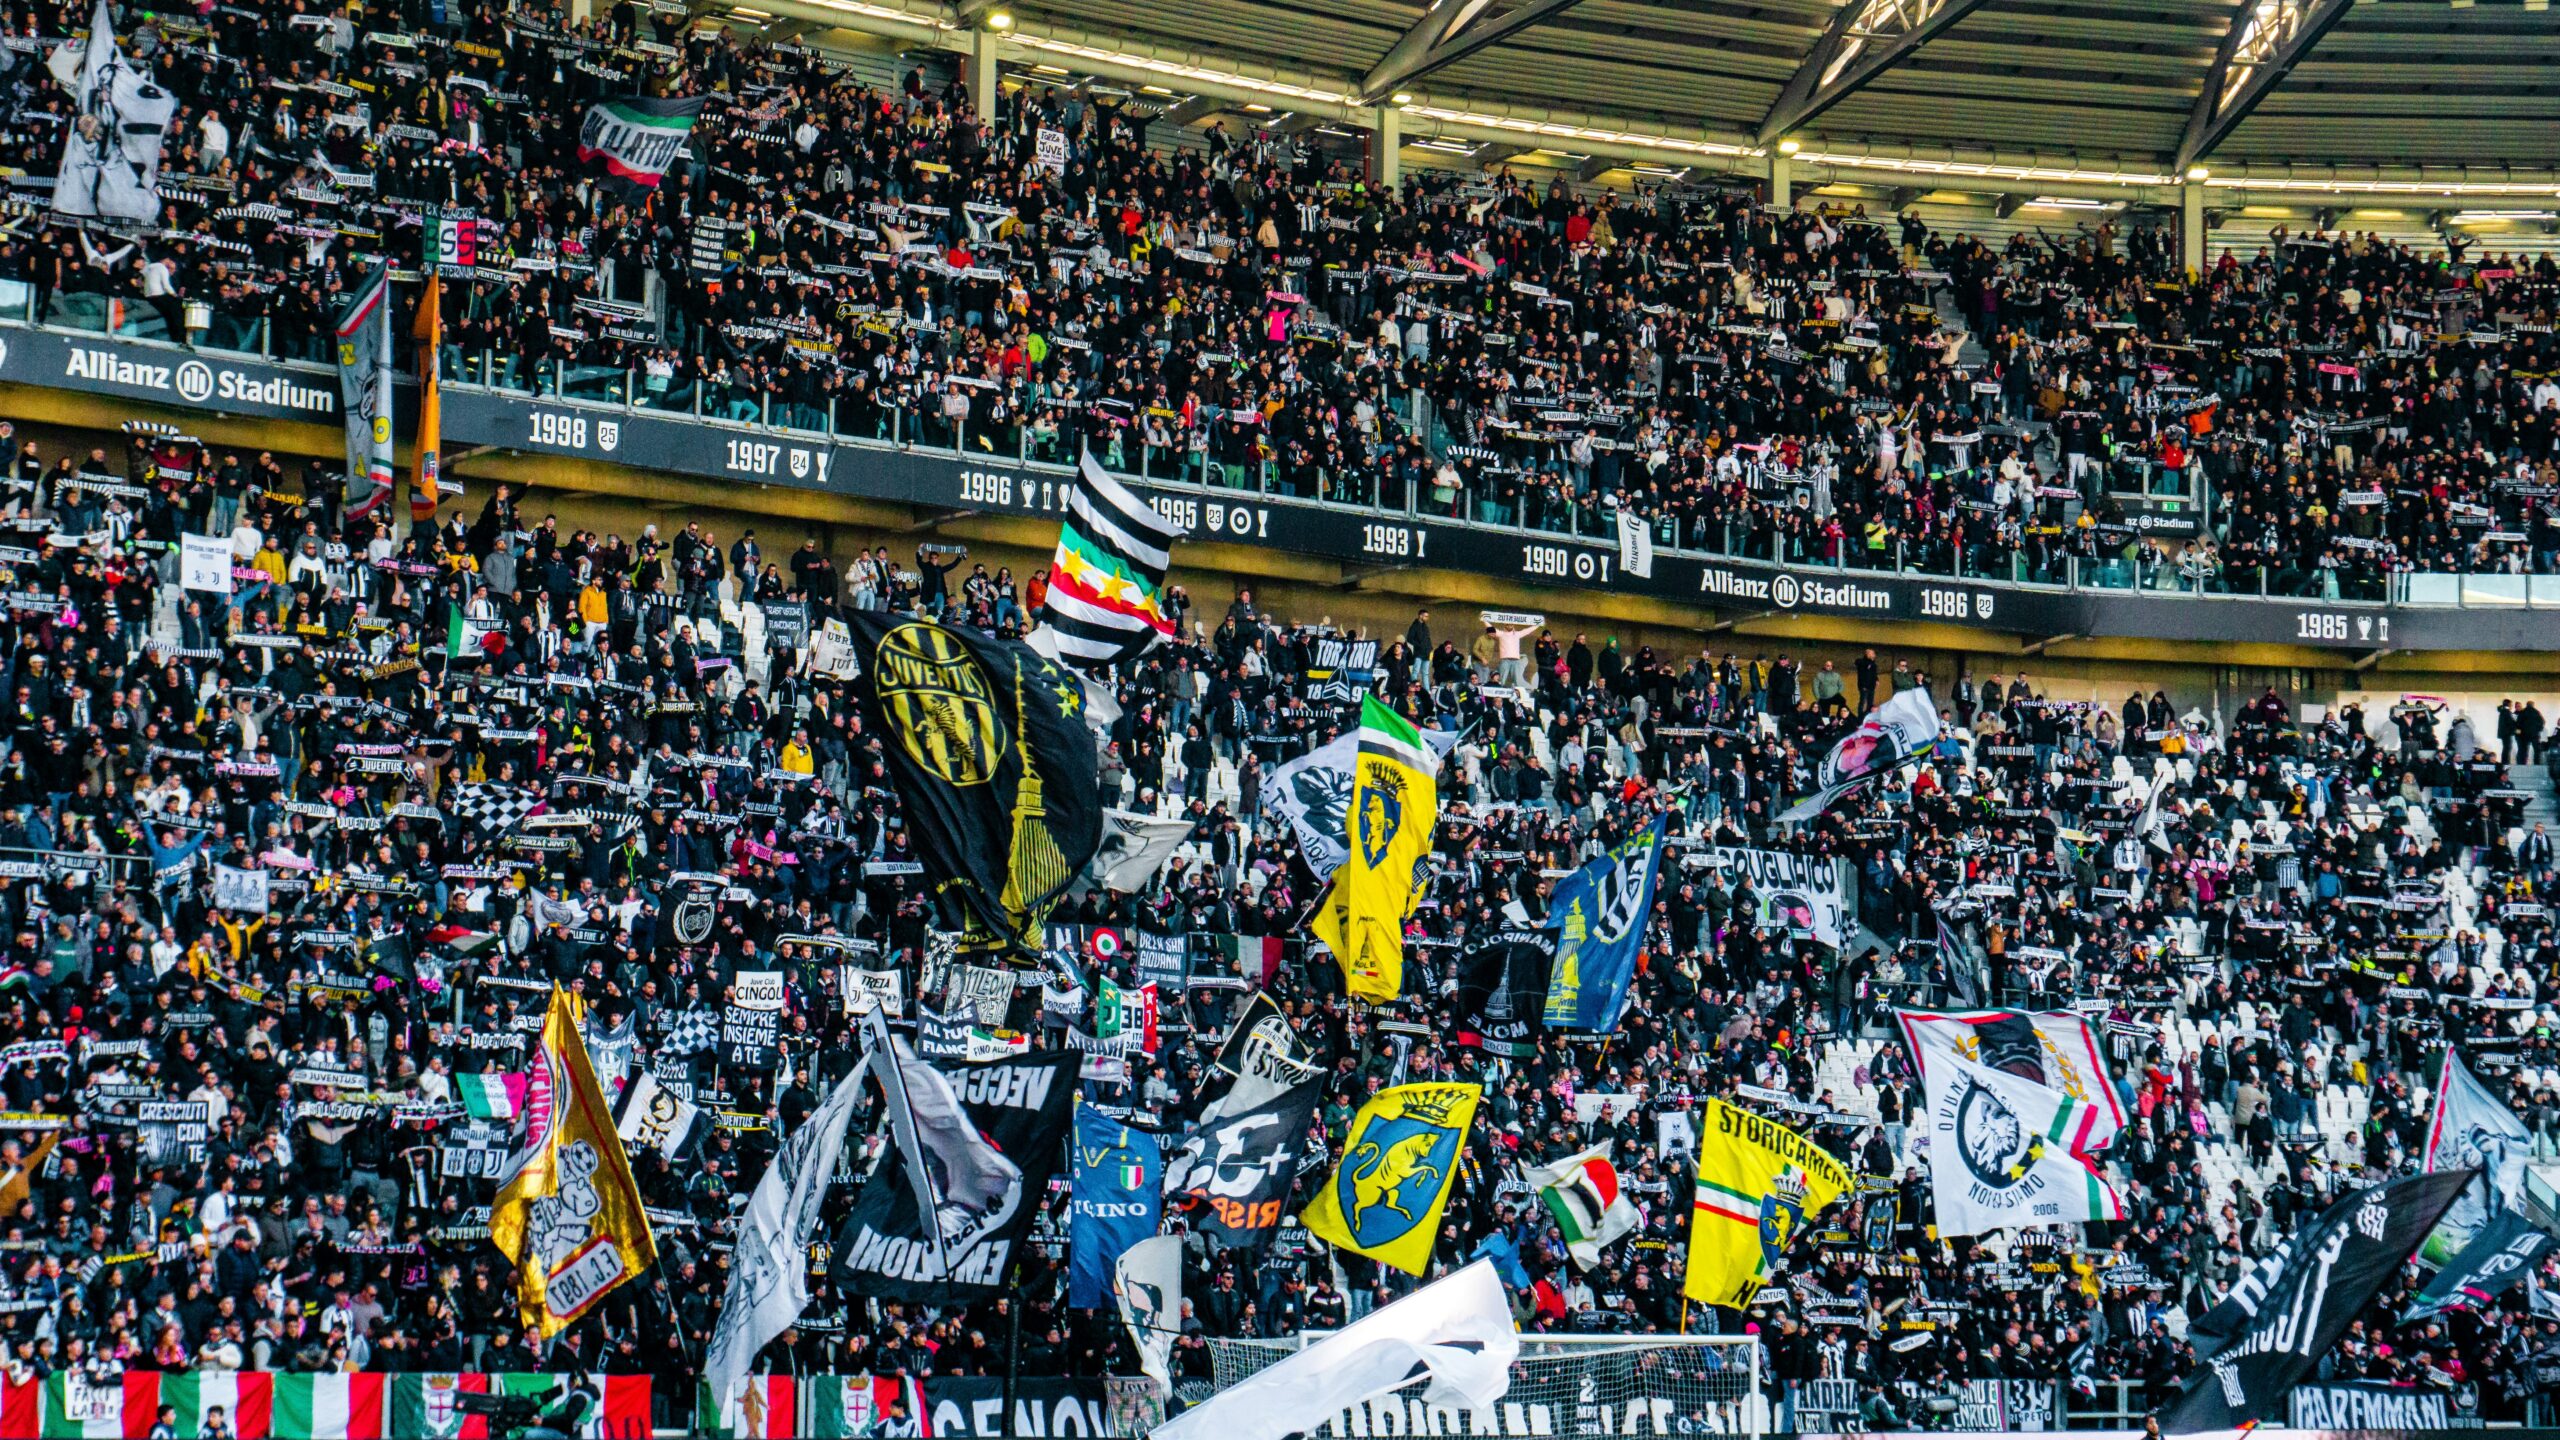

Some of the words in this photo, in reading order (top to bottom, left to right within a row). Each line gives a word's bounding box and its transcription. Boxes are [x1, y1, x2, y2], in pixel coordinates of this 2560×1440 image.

[655, 2, 686, 13] JUVENTUS
[320, 82, 353, 96] JUVENTUS
[348, 79, 374, 92] JUVENTUS
[1039, 142, 1062, 155] JUVE
[338, 175, 371, 186] JUVENTUS
[301, 188, 337, 203] JUVENTUS
[870, 203, 898, 214] JUVENTUS
[1292, 256, 1311, 267] JUVE
[477, 269, 502, 281] VENTUS
[863, 322, 889, 334] JUVENTUS
[911, 318, 937, 330] JUVENTUS
[1308, 322, 1339, 331] JUVENTUS
[608, 326, 618, 336] FINO
[621, 328, 632, 338] ALLA
[634, 331, 645, 341] FINE
[790, 340, 803, 351] FINO
[806, 341, 818, 352] ALLA
[822, 342, 834, 353] FINE
[1058, 338, 1087, 349] JUVENTUS
[1205, 353, 1231, 362] JUVENTUS
[66, 347, 170, 390] Allianz
[217, 371, 333, 413] Stadium
[1149, 408, 1174, 417] JUVENTUS
[1547, 411, 1579, 420] JUVENTUS
[529, 411, 586, 449] 1998
[601, 428, 614, 444] 25
[727, 440, 781, 475] 1997
[792, 455, 804, 471] 24
[160, 468, 190, 481] JUVENTUS
[959, 472, 1011, 505] 1996
[1150, 496, 1196, 529] 1995
[1208, 510, 1221, 525] 23
[2153, 518, 2194, 529] Stadium
[1363, 525, 1408, 556] 1993
[2341, 538, 2374, 548] JUVENTUS
[1626, 535, 1640, 572] JUVENTUS
[1523, 546, 1567, 576] 1990
[1700, 567, 1769, 599] Allianz
[1802, 580, 1890, 609] Stadium
[1921, 589, 1968, 617] 1986
[1978, 599, 1991, 613] 22
[358, 617, 388, 629] JUVENTUS
[2298, 614, 2348, 639] 1985
[827, 633, 850, 644] UBR
[1312, 641, 1375, 670] TORINO
[374, 657, 416, 677] JUVENTUS
[553, 674, 584, 686] JUVENTUS
[879, 655, 982, 697] JUVENTUS
[1307, 686, 1321, 699] 18
[1351, 686, 1368, 702] 97
[662, 702, 695, 713] JUVENTUS
[452, 714, 478, 725] JUVENTUS
[363, 761, 401, 772] JUVENTUS
[704, 755, 739, 765] JUVENTUS
[338, 818, 380, 829] JUVENTUS
[517, 838, 538, 848] FORZA
[547, 839, 567, 849] JUVE
[732, 889, 744, 899] FINE
[303, 932, 315, 941] FINO
[318, 933, 332, 942] ALLA
[334, 934, 347, 943] FINE
[963, 931, 995, 943] MOLE
[1140, 951, 1182, 970] GIOVANNI
[2364, 969, 2393, 980] JUVENTUS
[725, 1006, 776, 1028] SEMPRE
[1121, 1005, 1142, 1027] 38
[724, 1025, 776, 1047] INSIEME
[924, 1022, 940, 1037] AL
[942, 1026, 971, 1040] TUO
[924, 1040, 967, 1055] FIANC
[972, 1043, 989, 1056] FINO
[991, 1043, 1008, 1053] ALLA
[1067, 1031, 1125, 1058] SIBARI
[732, 1046, 746, 1061] A
[747, 1048, 761, 1065] TE
[311, 1073, 356, 1084] JUVENTUS
[102, 1086, 116, 1095] FINO
[118, 1086, 132, 1095] ALLA
[135, 1087, 149, 1095] FINE
[139, 1103, 205, 1120] CRESCIUTI
[1592, 1104, 1601, 1113] 18
[1613, 1104, 1622, 1113] 97
[177, 1123, 204, 1141] CON
[450, 1126, 466, 1142] FINO
[468, 1127, 485, 1141] ALLA
[487, 1127, 504, 1142] FINE
[188, 1145, 204, 1163] TE
[1719, 1124, 1850, 1190] STORICAMEN
[1074, 1199, 1148, 1218] TOINO
[2032, 1203, 2058, 1217] 2006
[444, 1228, 490, 1239] JUVENTUS
[1634, 1241, 1665, 1250] JUVENTUS
[815, 1246, 825, 1259] 10
[1796, 1382, 1858, 1410] ANDRIA
[2294, 1385, 2451, 1430] MAREMMANI
[932, 1396, 1110, 1438] GENOV
[1952, 1404, 1998, 1429] ENRICO
